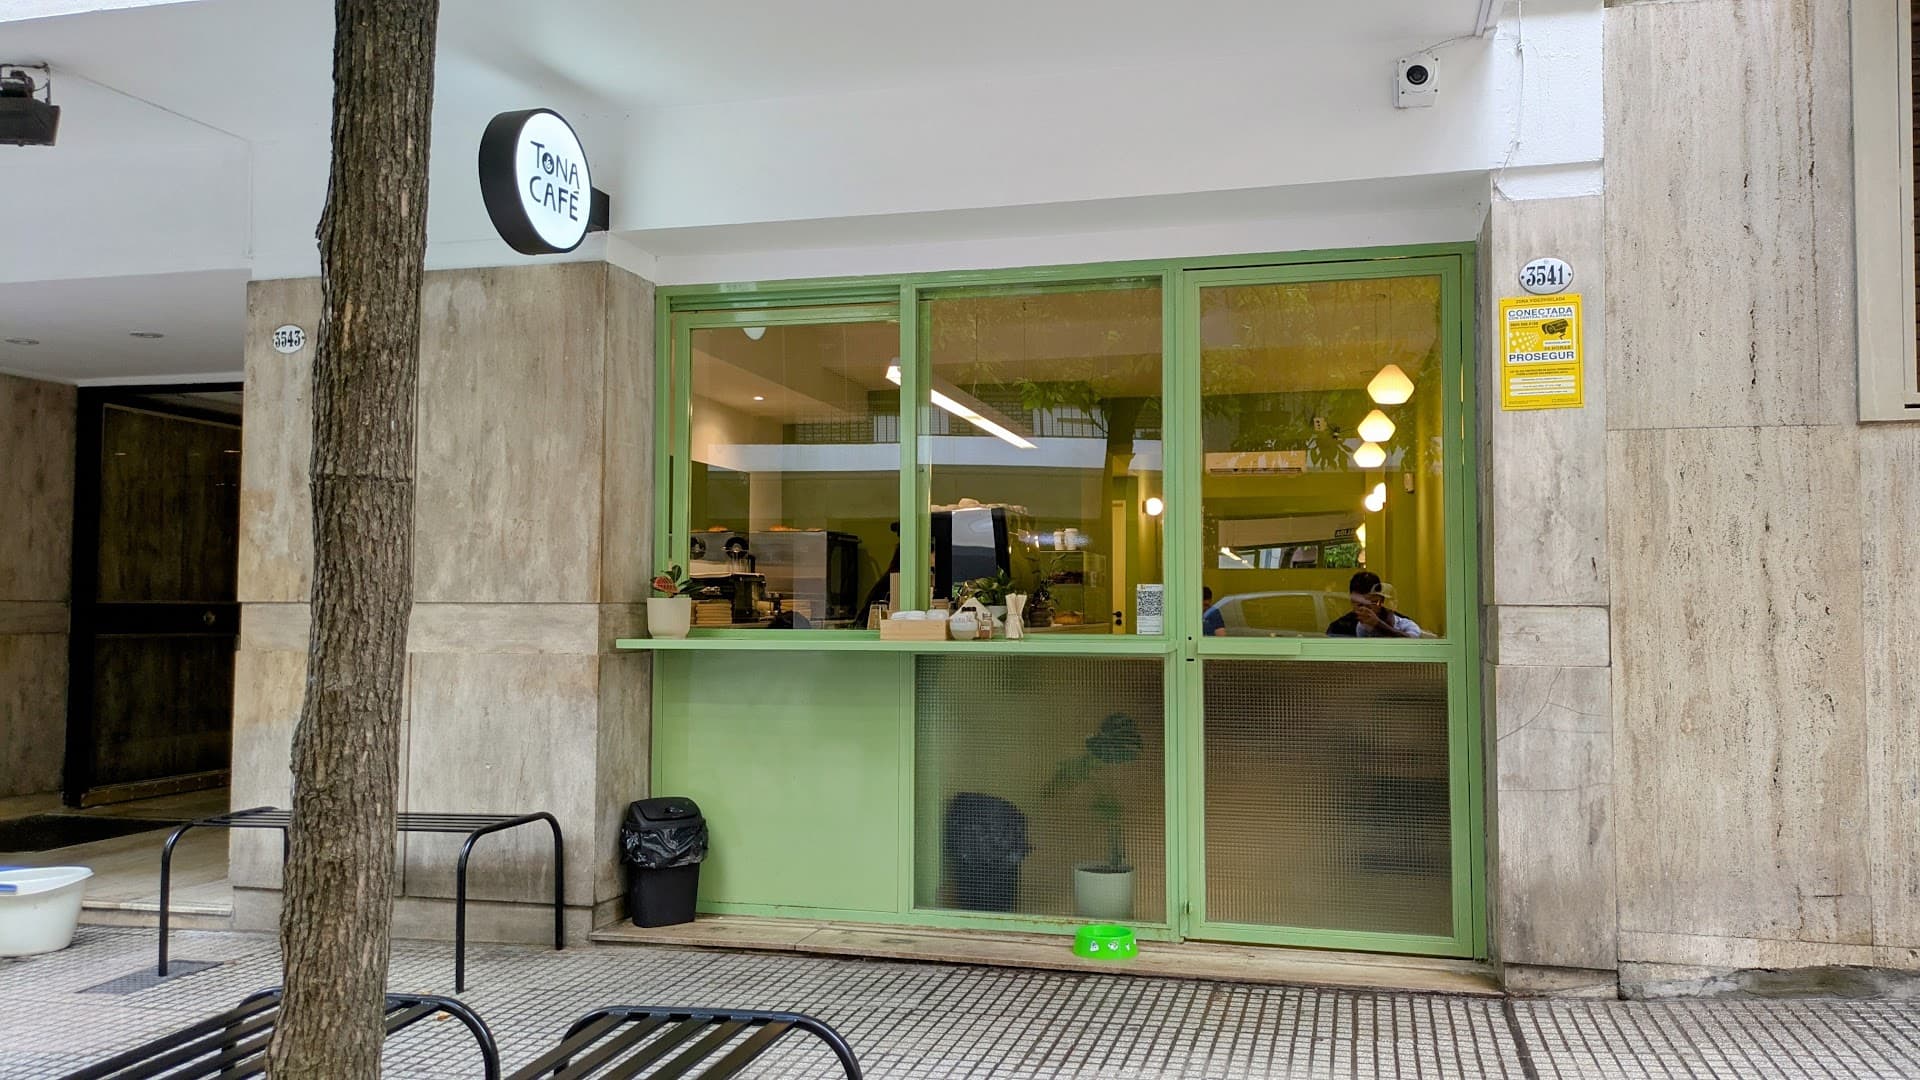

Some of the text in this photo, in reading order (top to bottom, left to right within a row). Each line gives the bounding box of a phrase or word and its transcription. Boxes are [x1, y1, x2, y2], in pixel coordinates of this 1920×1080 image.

[530, 140, 580, 190] TONA
[529, 176, 580, 222] CAFÉ
[1526, 264, 1565, 287] 3541
[1508, 307, 1573, 317] CONECTADA
[275, 330, 300, 348] 3543
[1509, 351, 1574, 362] PROSEGUR
